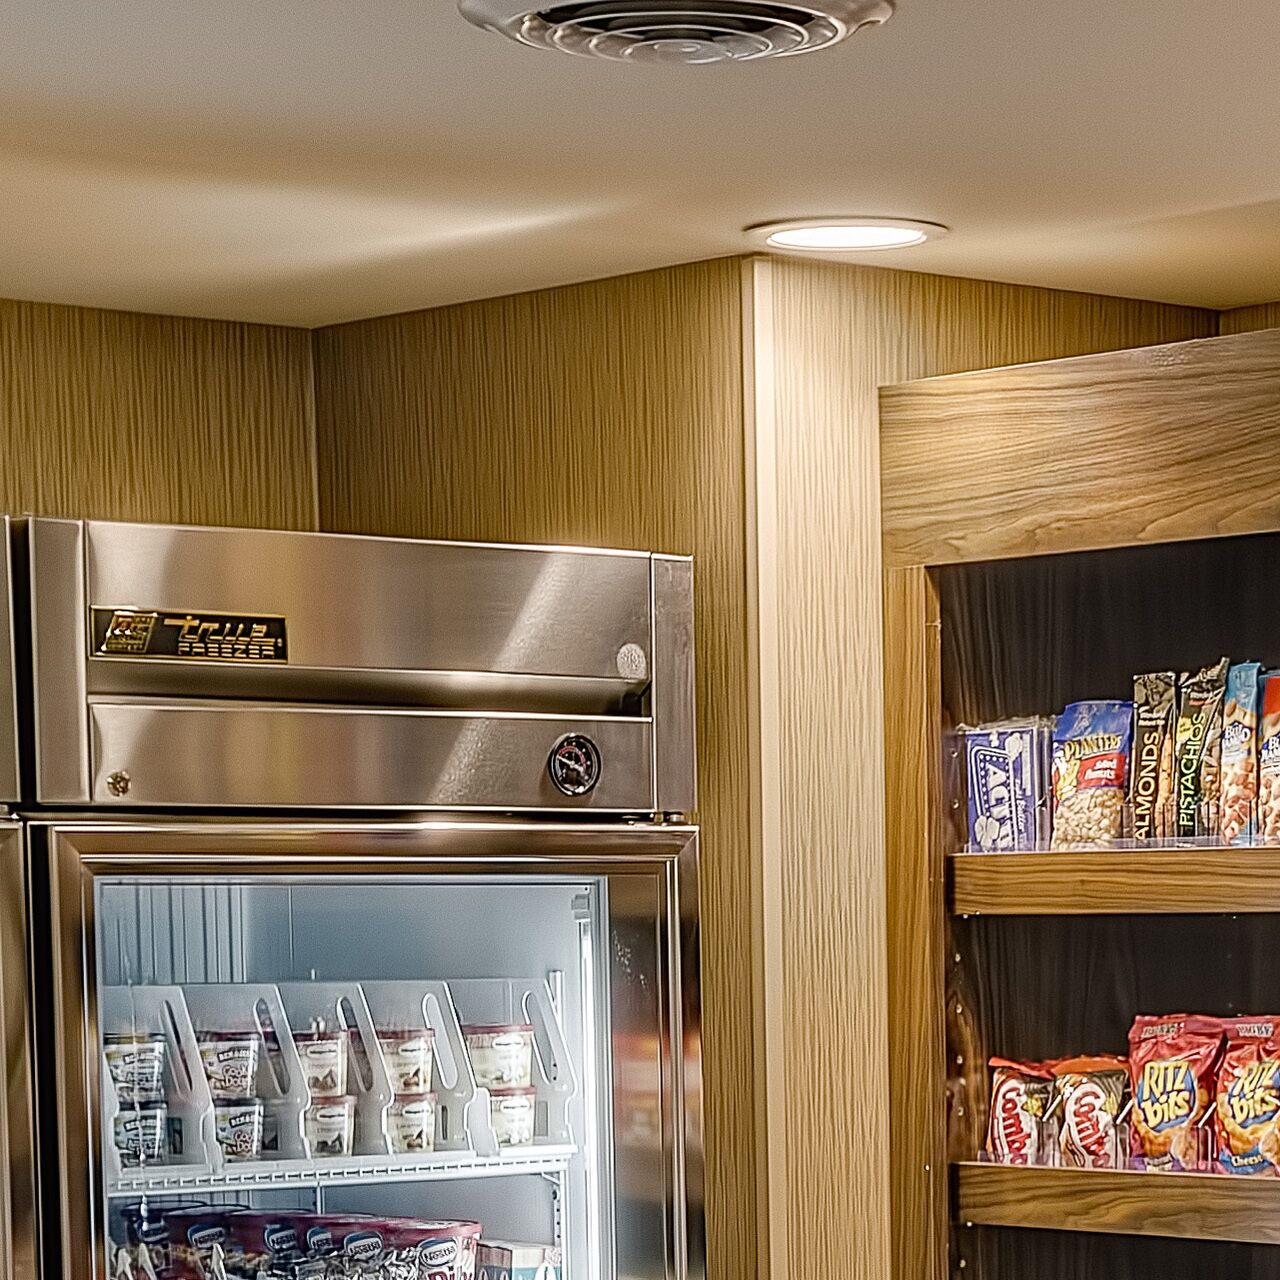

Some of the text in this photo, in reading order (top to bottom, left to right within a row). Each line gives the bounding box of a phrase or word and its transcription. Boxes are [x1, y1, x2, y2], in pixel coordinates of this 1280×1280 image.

[164, 615, 276, 646] true
[178, 643, 275, 658] FREEZER
[1064, 733, 1122, 761] PLANTERS
[1134, 731, 1159, 841] ALMONDS
[1179, 712, 1206, 826] PISTACHIOS
[1142, 1062, 1190, 1099] RITZ
[1141, 1093, 1190, 1127] bits
